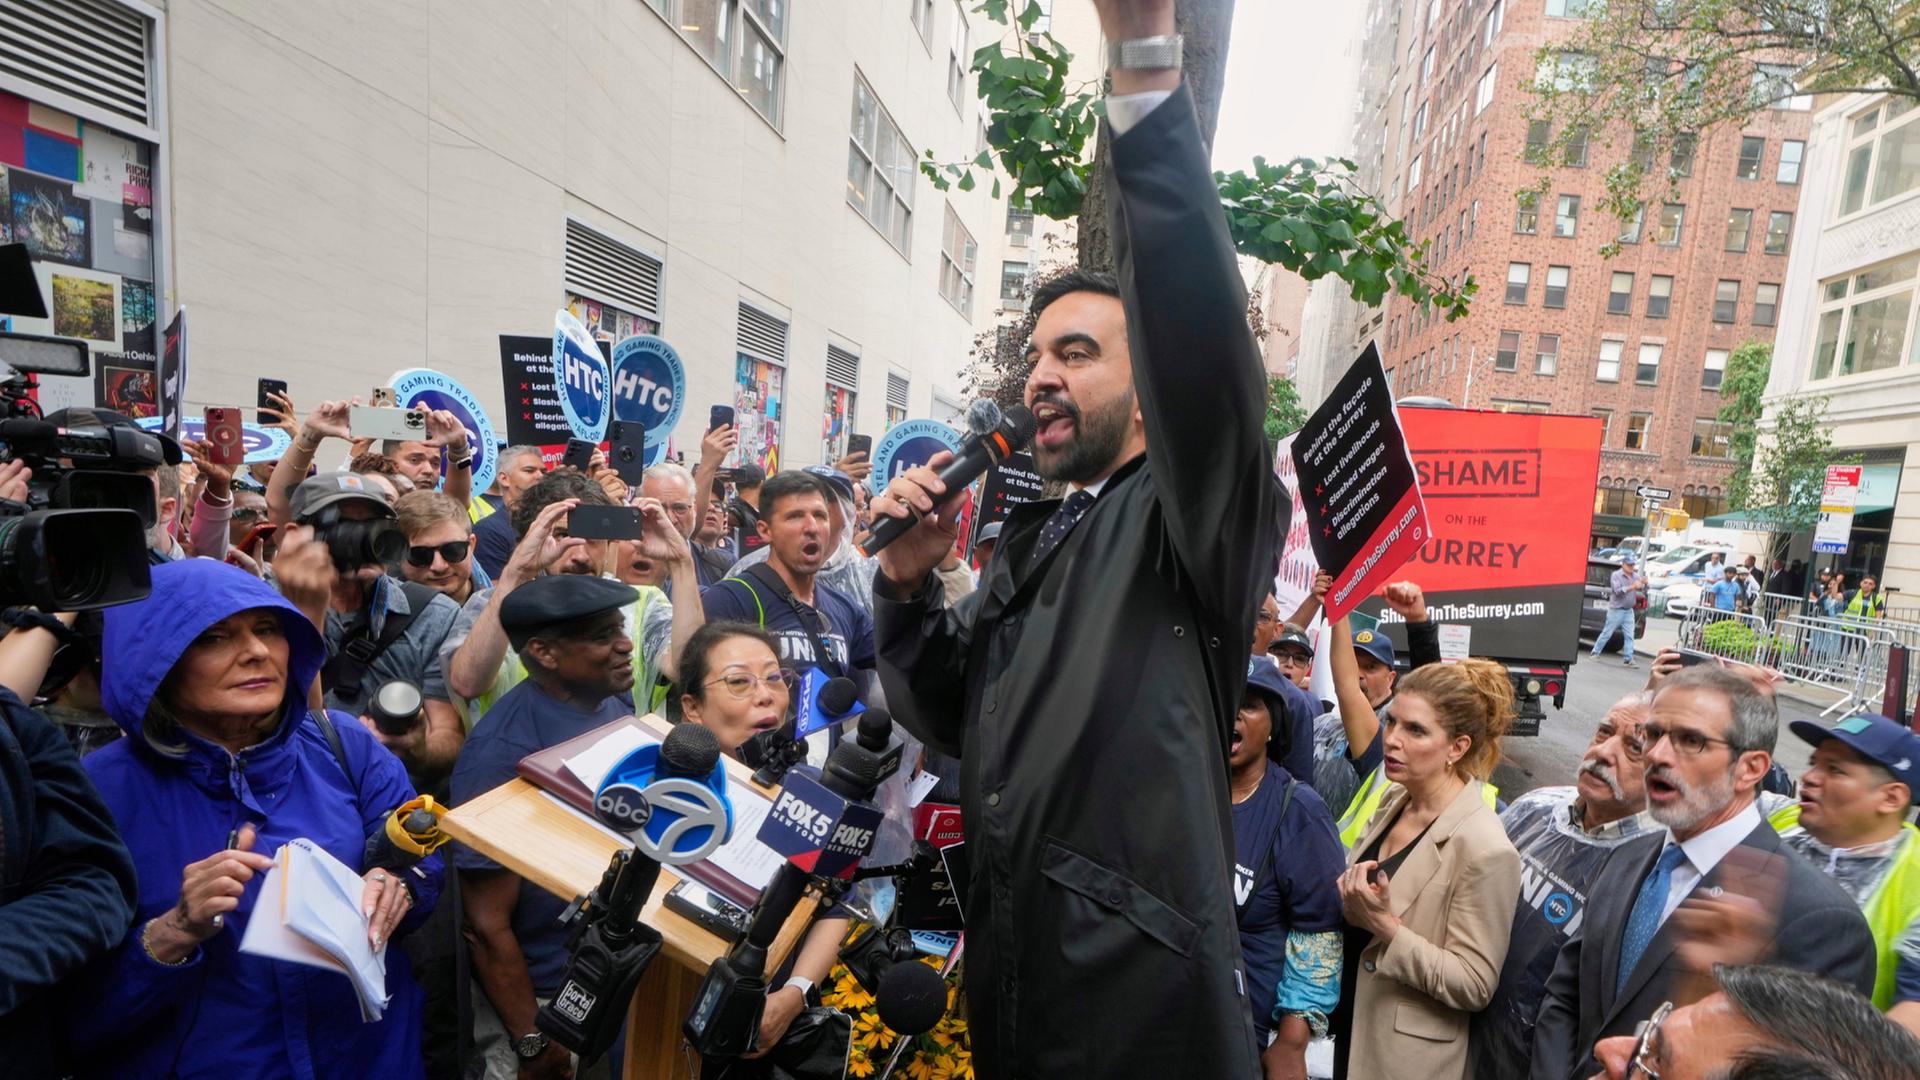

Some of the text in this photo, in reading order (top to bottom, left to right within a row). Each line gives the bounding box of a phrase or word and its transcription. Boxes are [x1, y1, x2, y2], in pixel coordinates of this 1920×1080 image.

[514, 353, 547, 363] Behind
[625, 341, 660, 351] GAMING
[526, 365, 554, 373] at the
[565, 352, 602, 400] HTC
[532, 383, 550, 391] Lost
[615, 369, 672, 413] HTC
[401, 376, 444, 393] GAMING
[449, 384, 485, 424] TRADES
[481, 430, 494, 479] COUNCIL
[1303, 428, 1328, 464] Behind
[1328, 413, 1342, 431] the
[1314, 402, 1366, 466] at the Surrey:
[881, 441, 894, 463] AND
[896, 424, 938, 440] GAMING
[1323, 419, 1380, 486] Lost livelihoods
[998, 465, 1041, 481] Behind the
[1016, 479, 1030, 488] the
[1328, 442, 1386, 507] Slashed wages
[1415, 460, 1528, 486] SHAME
[1006, 494, 1021, 503] Lost
[1331, 465, 1388, 527] Discrimination
[1337, 492, 1380, 540] allegations
[1445, 514, 1487, 526] ON THE
[1334, 504, 1418, 606] ShameOnTheSurrey.com
[1380, 602, 1545, 624] ShaOnTheSurrey.com
[597, 795, 649, 823] abc
[772, 810, 822, 846] NEW YORK
[827, 844, 863, 856] NEW YORK
[1549, 872, 1575, 895] GAMING
[1549, 899, 1566, 916] HTC
[563, 984, 592, 1010] porta
